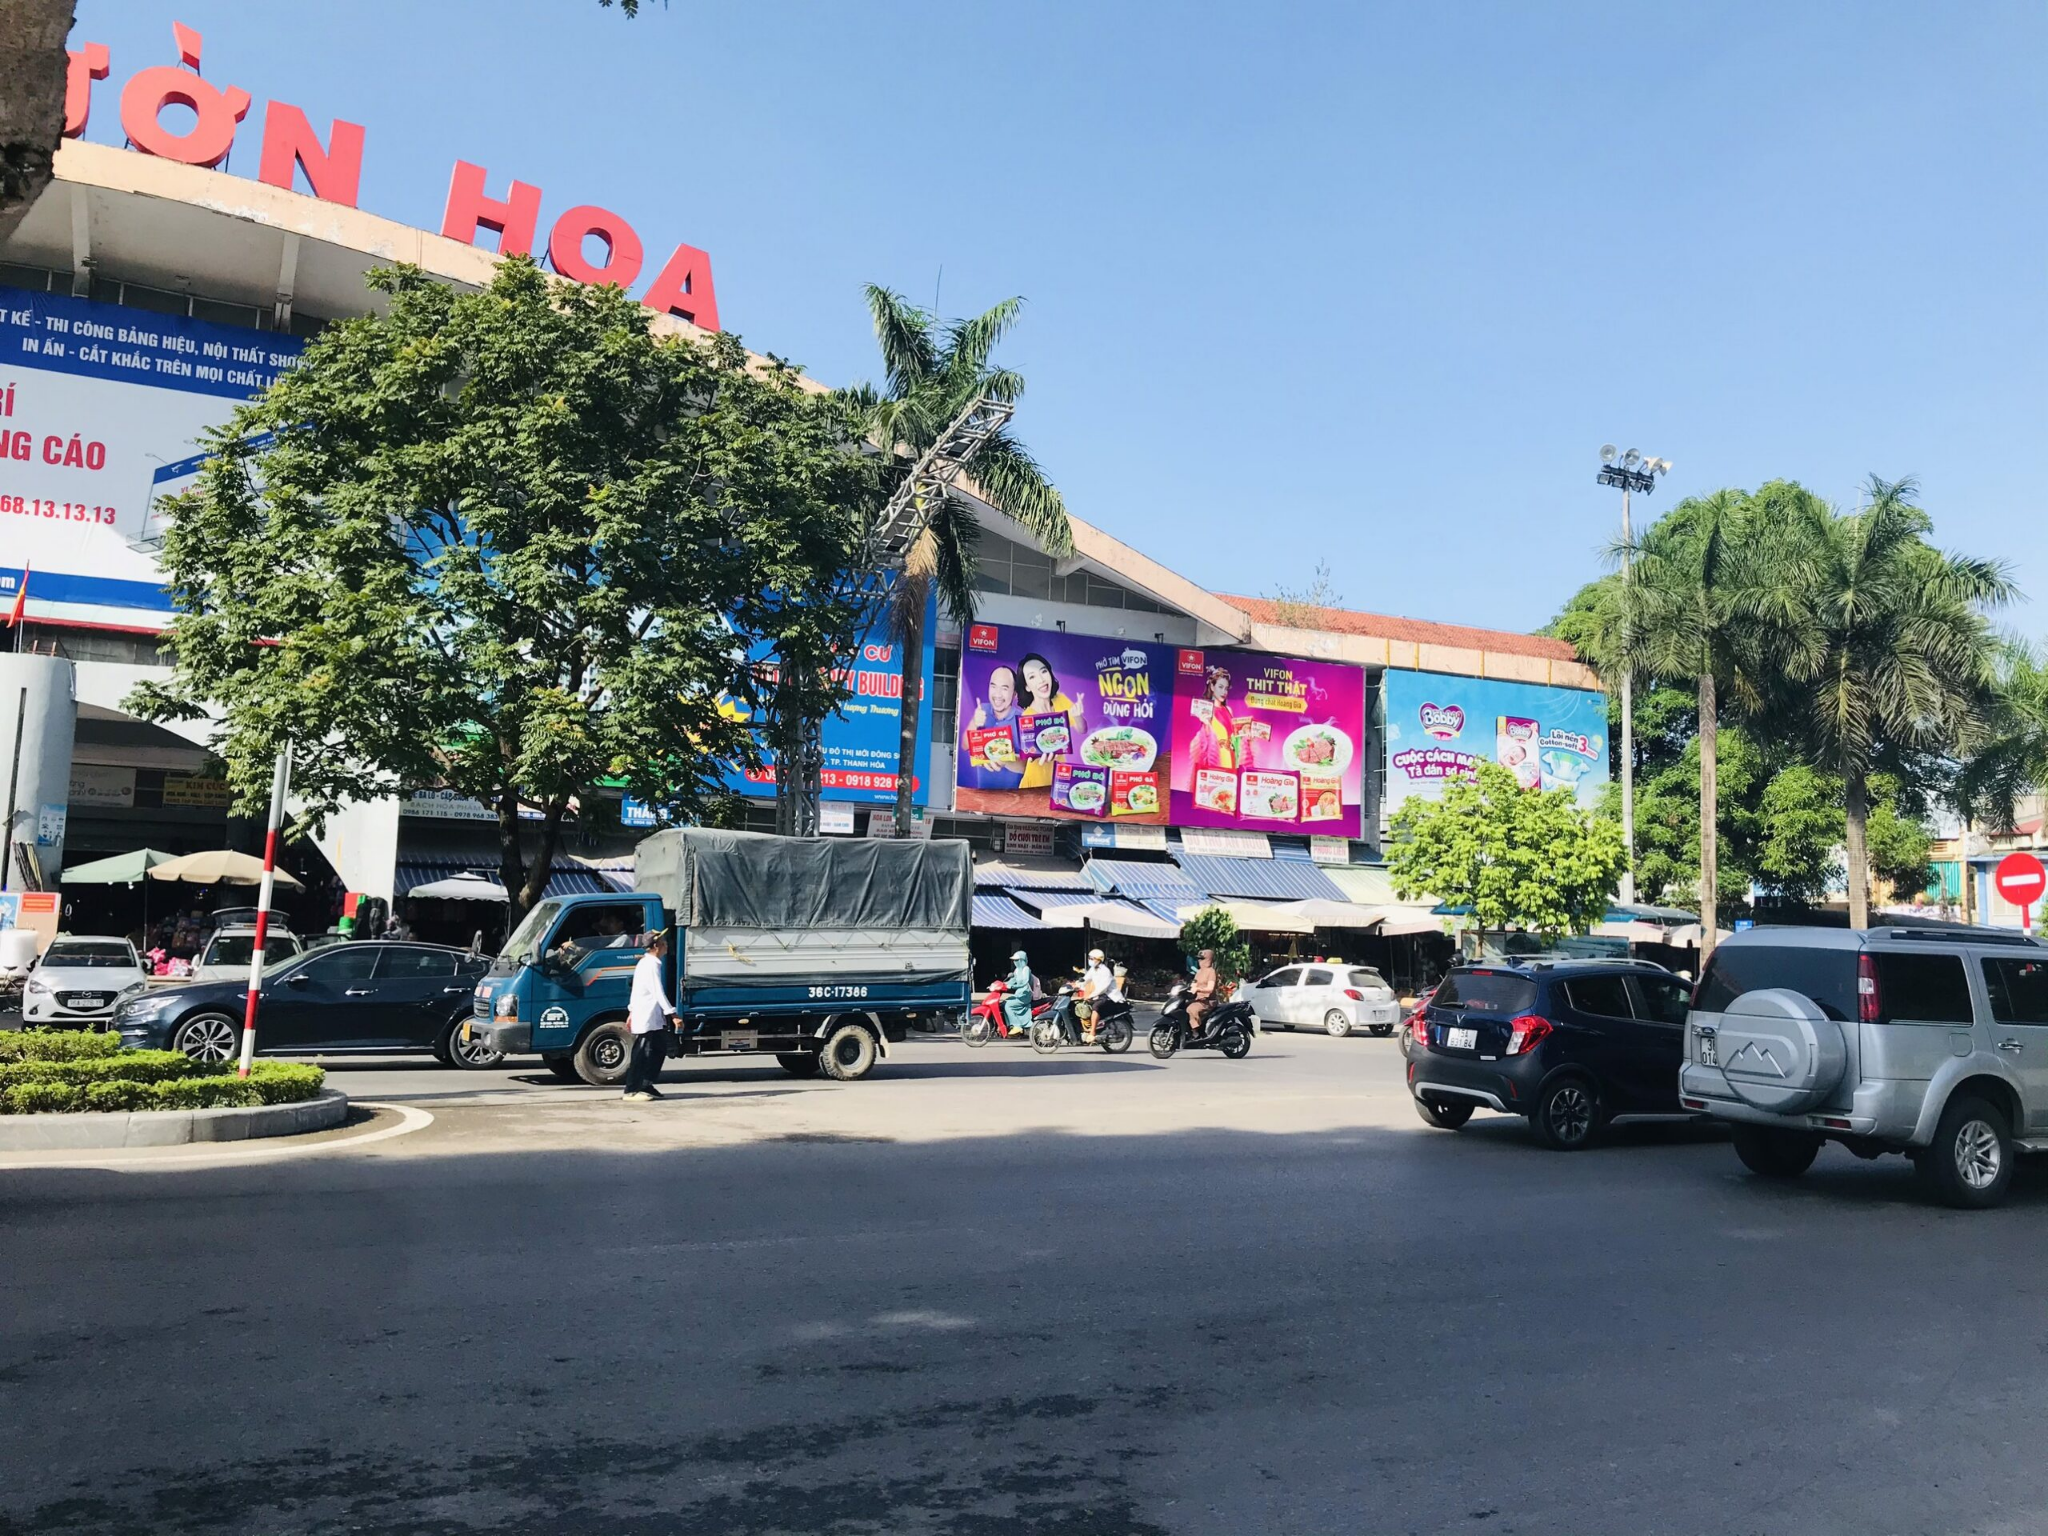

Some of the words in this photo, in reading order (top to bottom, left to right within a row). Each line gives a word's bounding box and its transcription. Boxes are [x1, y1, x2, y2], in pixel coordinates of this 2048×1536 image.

[440, 159, 721, 331] HOA
[11, 309, 33, 327] KẾ
[45, 316, 69, 333] THI
[73, 320, 114, 341] CÔNG
[118, 326, 158, 347] BẢNG
[162, 335, 199, 356] HIỆU,
[203, 341, 228, 361] NỘI
[232, 345, 266, 365] THẤT
[22, 337, 39, 353] IN
[42, 337, 65, 357] ẤN
[79, 344, 108, 364] CẮT
[111, 350, 151, 371] KHẮC
[155, 358, 191, 377] TRÊN
[196, 366, 223, 384] MỌI
[227, 368, 263, 388] CHẤT
[42, 433, 106, 470] CÁO
[973, 638, 995, 647] VIFON
[1122, 656, 1147, 664] VIFON
[1181, 662, 1201, 670] VIFON
[1263, 667, 1293, 680] VIFON
[1098, 672, 1149, 698] NGON
[1246, 678, 1274, 694] THỊT
[1277, 680, 1307, 697] THẬT
[1103, 700, 1130, 717] ĐỪNG
[871, 748, 892, 759] ĐÔNG
[1395, 750, 1425, 766] CUỘC
[1425, 748, 1455, 763] CÁCH
[843, 759, 868, 768] THANH
[869, 759, 885, 769] HÓA
[1424, 763, 1442, 775] dán
[846, 775, 871, 787] 0918
[874, 776, 892, 788] 928
